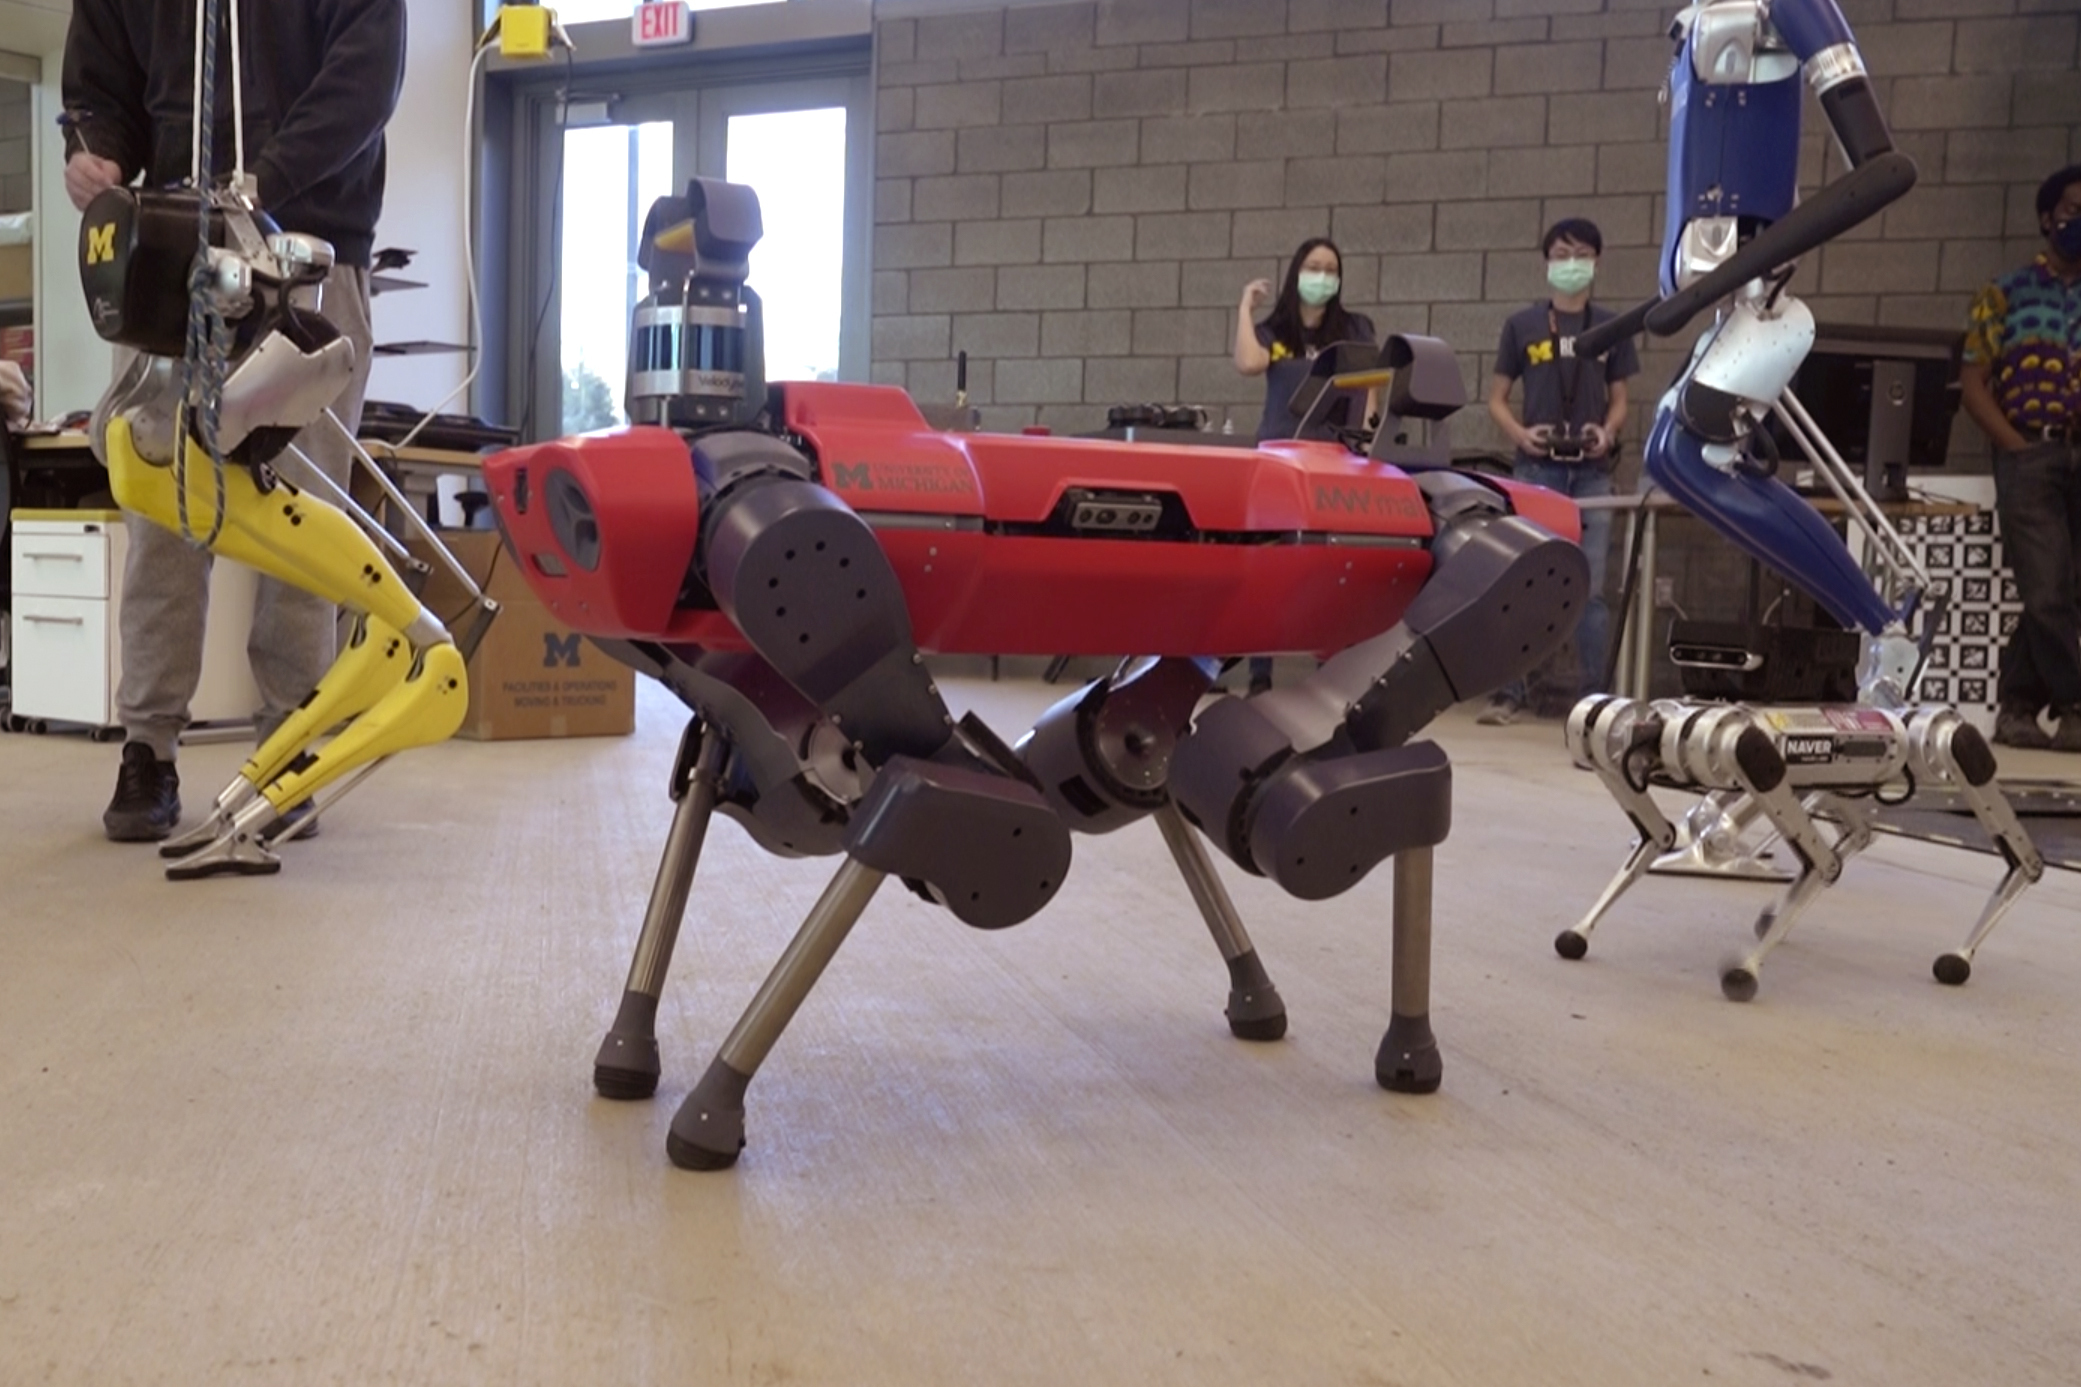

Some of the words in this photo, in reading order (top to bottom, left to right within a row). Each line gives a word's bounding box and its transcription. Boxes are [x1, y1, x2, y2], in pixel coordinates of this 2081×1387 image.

[641, 2, 679, 40] EXIT
[87, 222, 116, 265] M
[1526, 340, 1553, 365] M
[833, 462, 873, 490] M
[878, 476, 973, 493] MICHIGAN
[543, 633, 582, 668] M
[1787, 740, 1832, 754] NAVER
